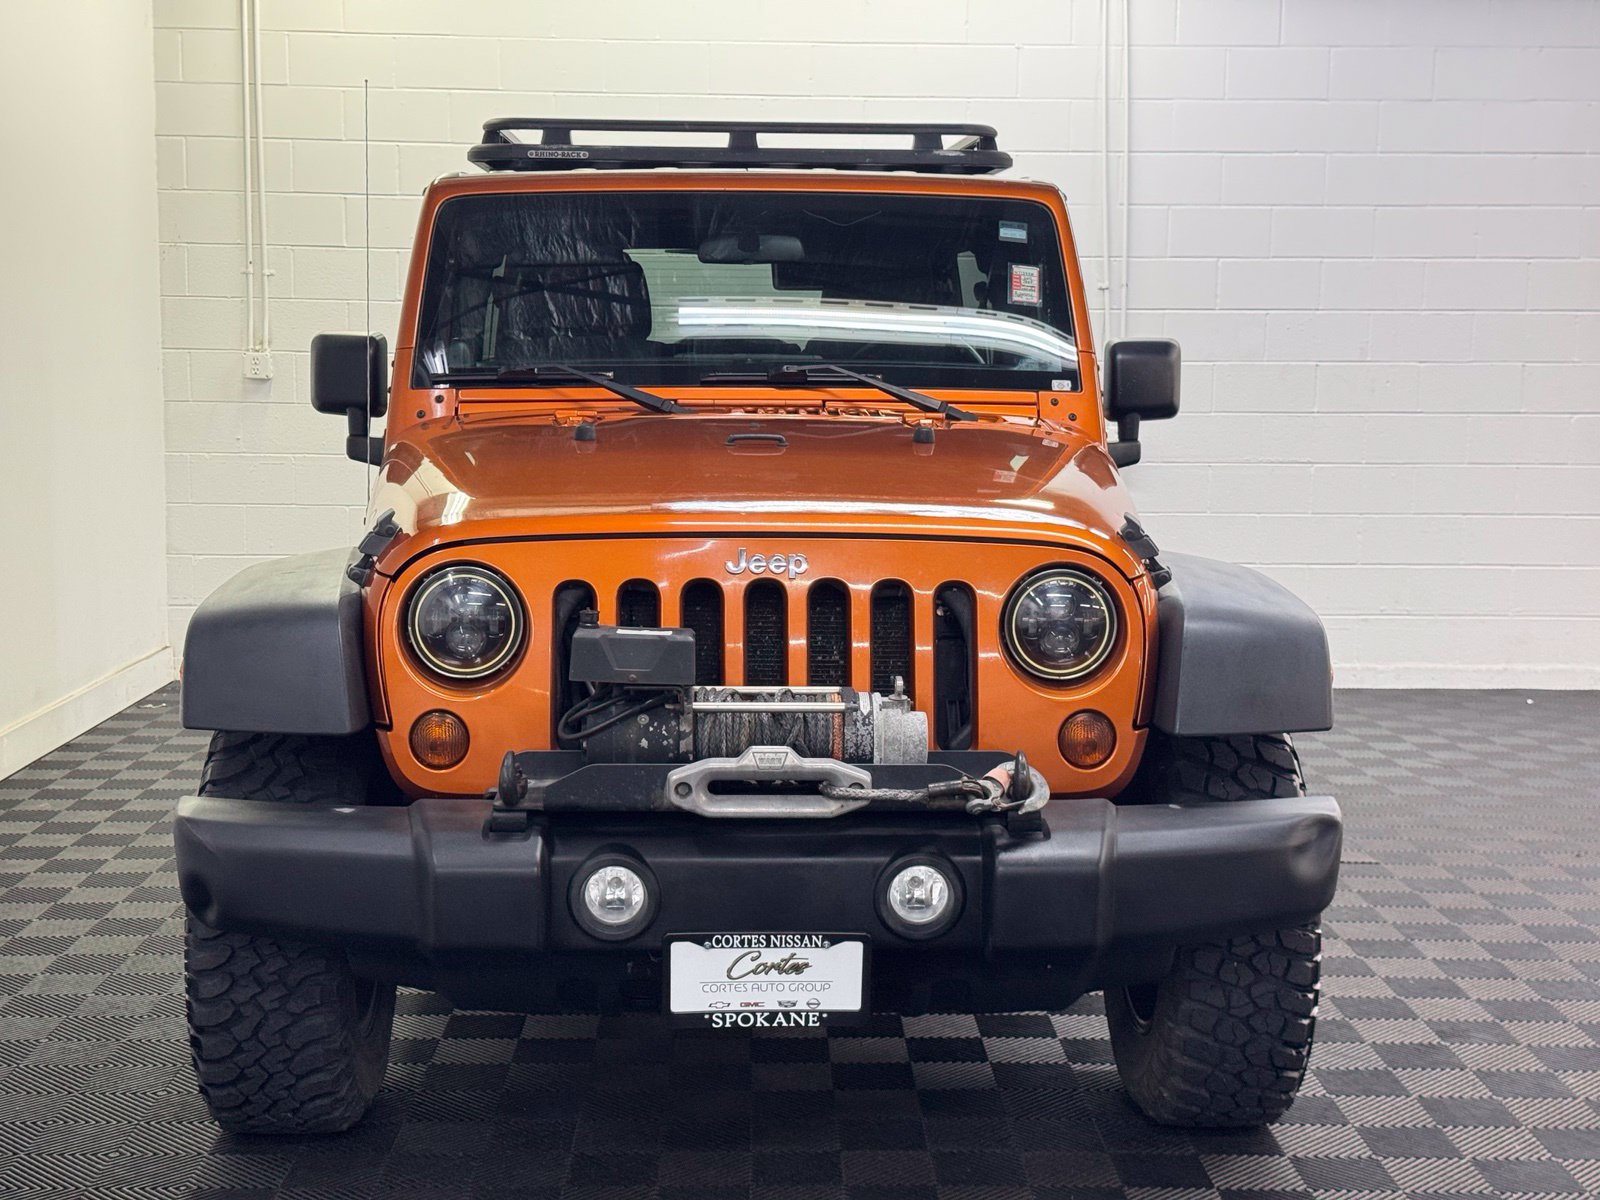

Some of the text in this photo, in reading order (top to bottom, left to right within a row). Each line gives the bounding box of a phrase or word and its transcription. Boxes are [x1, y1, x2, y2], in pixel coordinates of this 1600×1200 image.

[725, 547, 809, 580] Jeep
[711, 934, 823, 948] CORTES NISSAN
[726, 950, 813, 980] Cortes
[701, 982, 831, 993] CORTES AUTO GROUP
[711, 1011, 820, 1028] SPOKANE
